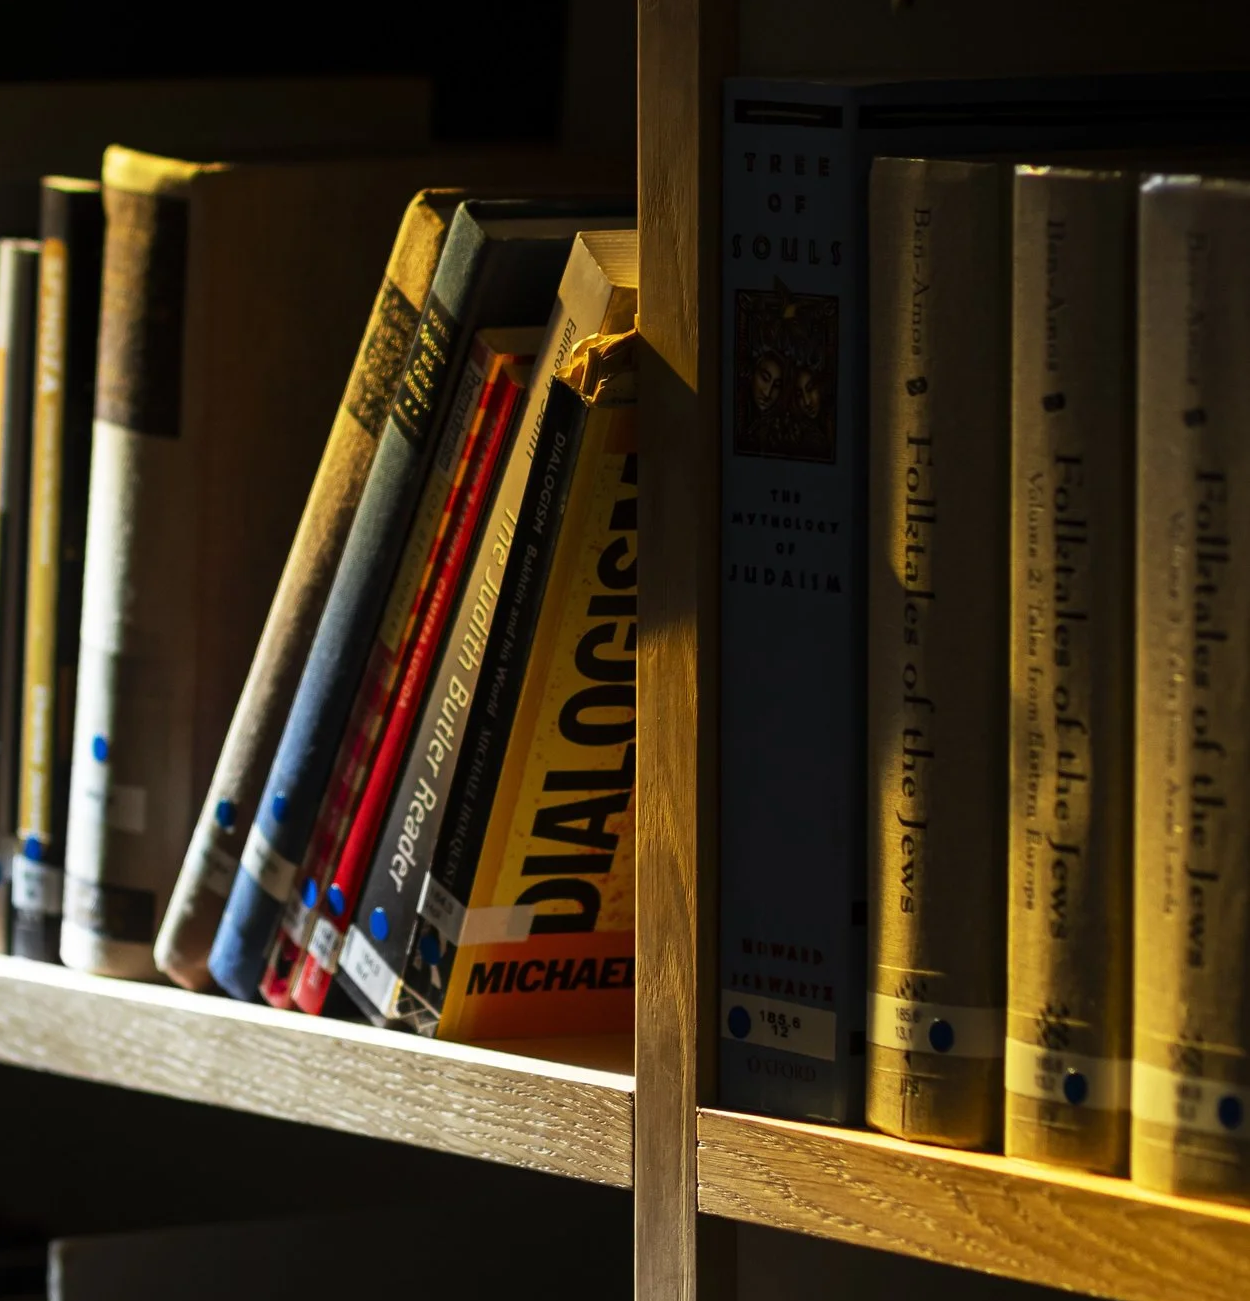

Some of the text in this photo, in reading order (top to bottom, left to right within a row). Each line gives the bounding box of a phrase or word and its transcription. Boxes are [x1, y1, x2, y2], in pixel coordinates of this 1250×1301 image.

[745, 152, 831, 178] TREE
[768, 193, 806, 214] OF
[732, 234, 843, 266] SOULS
[910, 207, 931, 356] Ben-Amos
[531, 431, 566, 536] DIALOGISM
[770, 489, 802, 504] THE
[732, 512, 840, 534] MYTHOLOGY
[1027, 471, 1045, 559] Volume
[776, 542, 796, 555] OF
[514, 543, 538, 605] Bakhtin
[729, 564, 842, 593] JUDAISM
[397, 576, 449, 709] CAMERA LUCIDA
[506, 605, 524, 640] and
[1028, 600, 1046, 657] Tales
[500, 634, 517, 662] his
[487, 665, 509, 718] World
[896, 431, 937, 914] Folktales of the Jews
[1027, 667, 1045, 722] from
[388, 507, 518, 893] The Judith Butler Reader
[1048, 454, 1088, 942] Folktales of the Jews
[1183, 470, 1231, 969] Folktales of the Jews
[1025, 731, 1046, 819] Eastern
[1023, 828, 1043, 911] Europe
[742, 938, 825, 965] HOWARD
[731, 971, 833, 1002] SCHWARTZ
[760, 1009, 801, 1029] 185.6
[772, 1024, 789, 1038] 12
[746, 1056, 817, 1082] OXFORD
